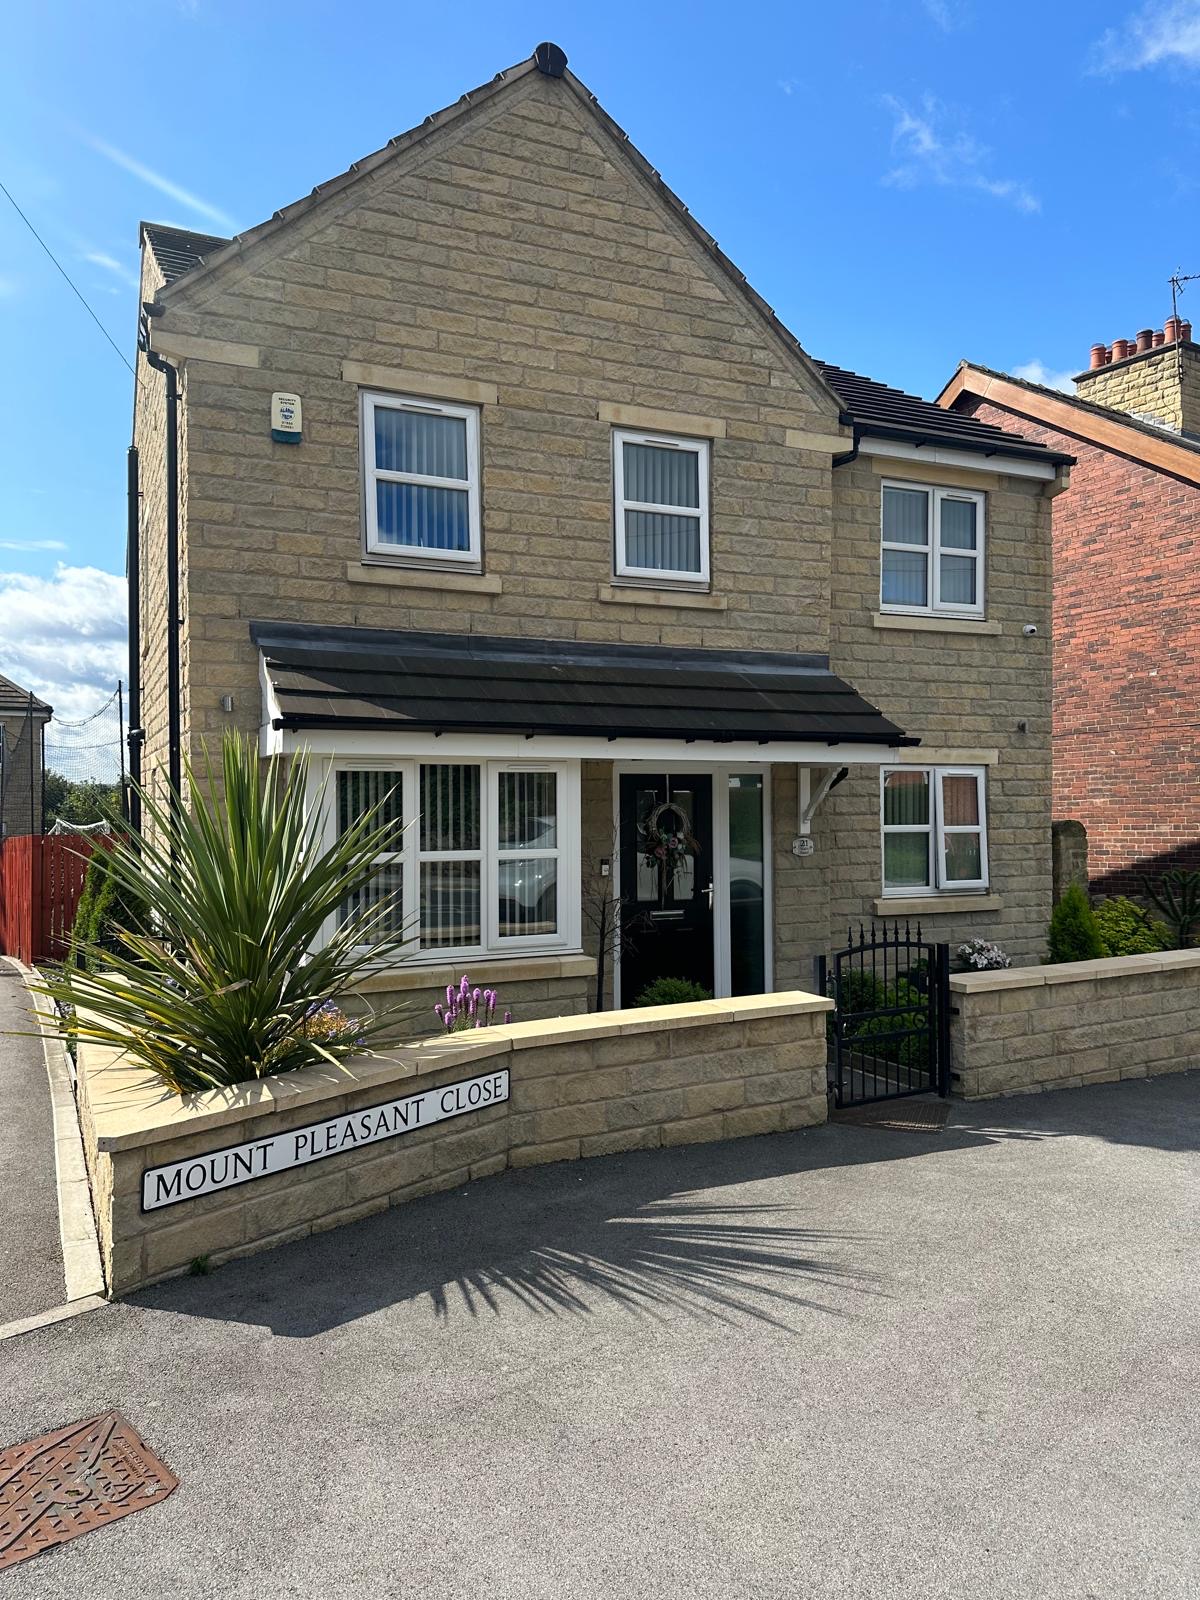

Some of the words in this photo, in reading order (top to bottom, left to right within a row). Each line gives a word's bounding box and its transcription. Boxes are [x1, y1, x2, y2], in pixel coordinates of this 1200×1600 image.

[800, 839, 808, 847] 21
[155, 1142, 274, 1202] MOUNT
[294, 1098, 425, 1161] PLEASANT
[441, 1076, 503, 1113] CLOSE
